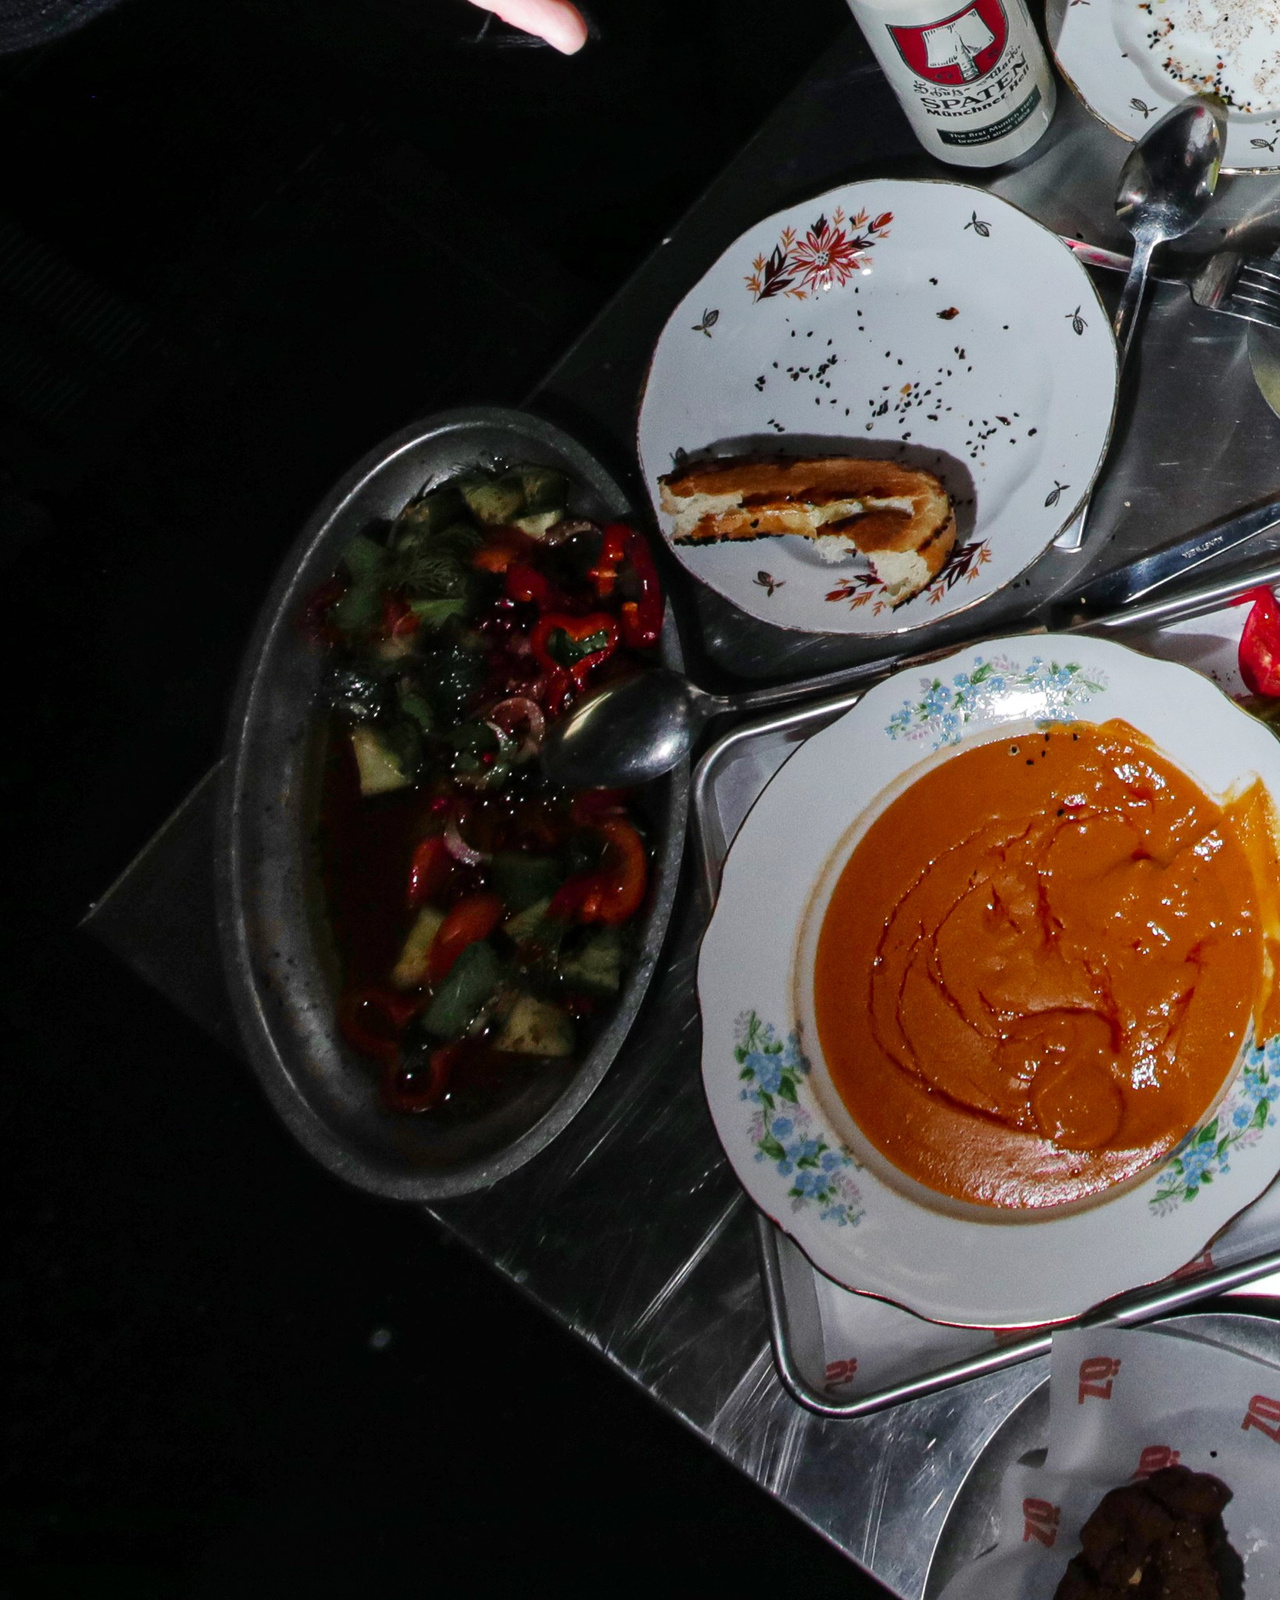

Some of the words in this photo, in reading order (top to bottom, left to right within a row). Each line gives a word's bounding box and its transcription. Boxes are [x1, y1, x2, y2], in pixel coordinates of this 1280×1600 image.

[920, 51, 1026, 109] SPATEN
[926, 93, 1006, 117] Münchner
[1009, 63, 1030, 92] Hell
